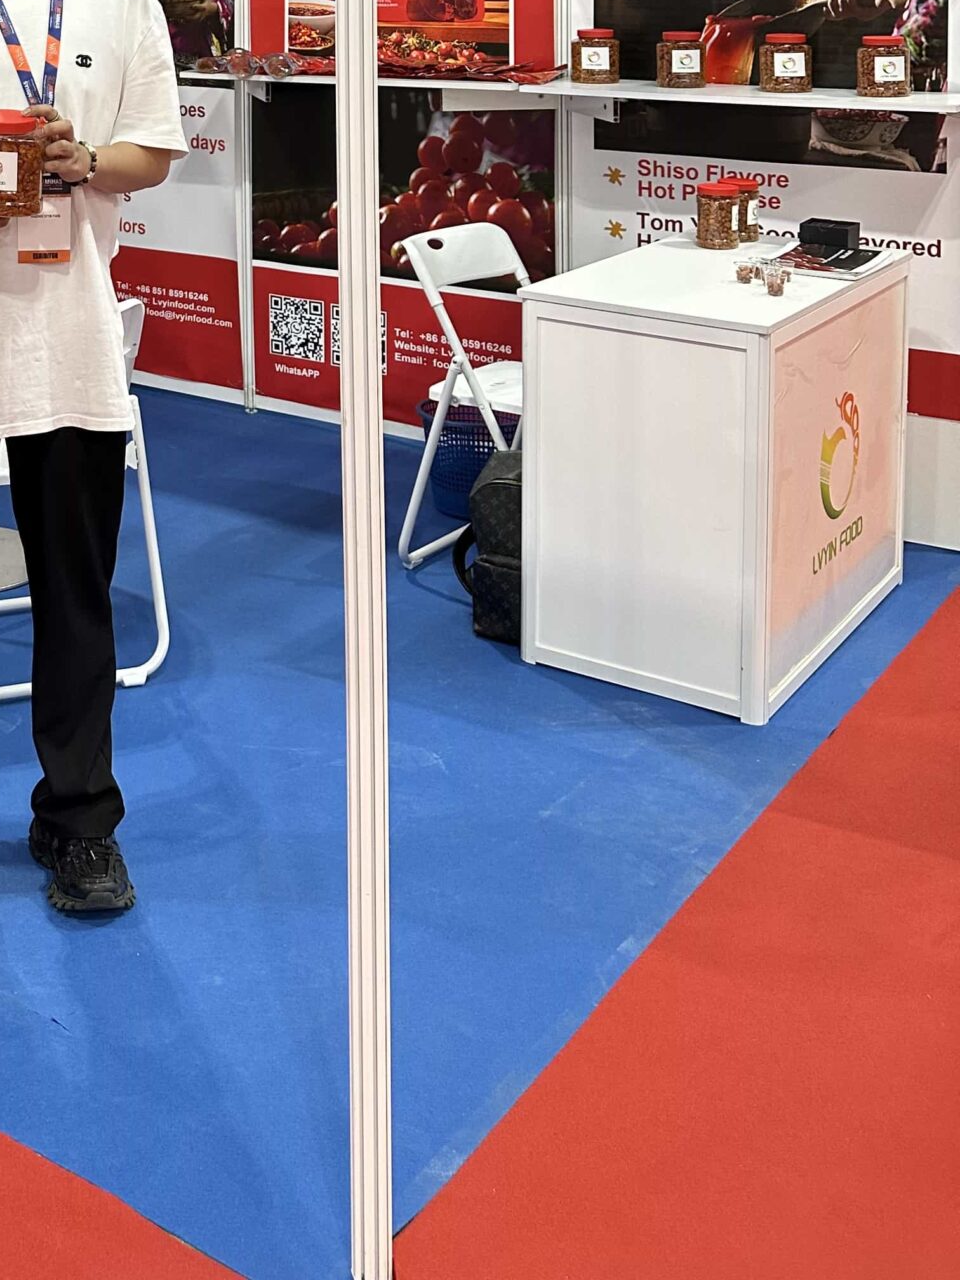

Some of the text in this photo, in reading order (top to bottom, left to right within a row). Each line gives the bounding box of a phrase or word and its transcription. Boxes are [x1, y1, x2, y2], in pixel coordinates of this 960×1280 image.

[190, 133, 226, 154] days
[637, 159, 699, 182] Shiso
[637, 180, 675, 200] Hot
[636, 211, 683, 233] Tom
[116, 281, 132, 290] Tel:
[152, 287, 166, 296] 851
[152, 297, 215, 314] Lvyinfood.com
[146, 307, 233, 328] food@lvyinfood.com
[394, 328, 414, 339] Tel:
[419, 333, 439, 343] +86
[462, 338, 512, 354] 85916246
[394, 339, 439, 355] Website:
[394, 352, 427, 366] Email:
[275, 362, 320, 378] WhatsAPP
[813, 516, 863, 574] LVYIN FOOD
